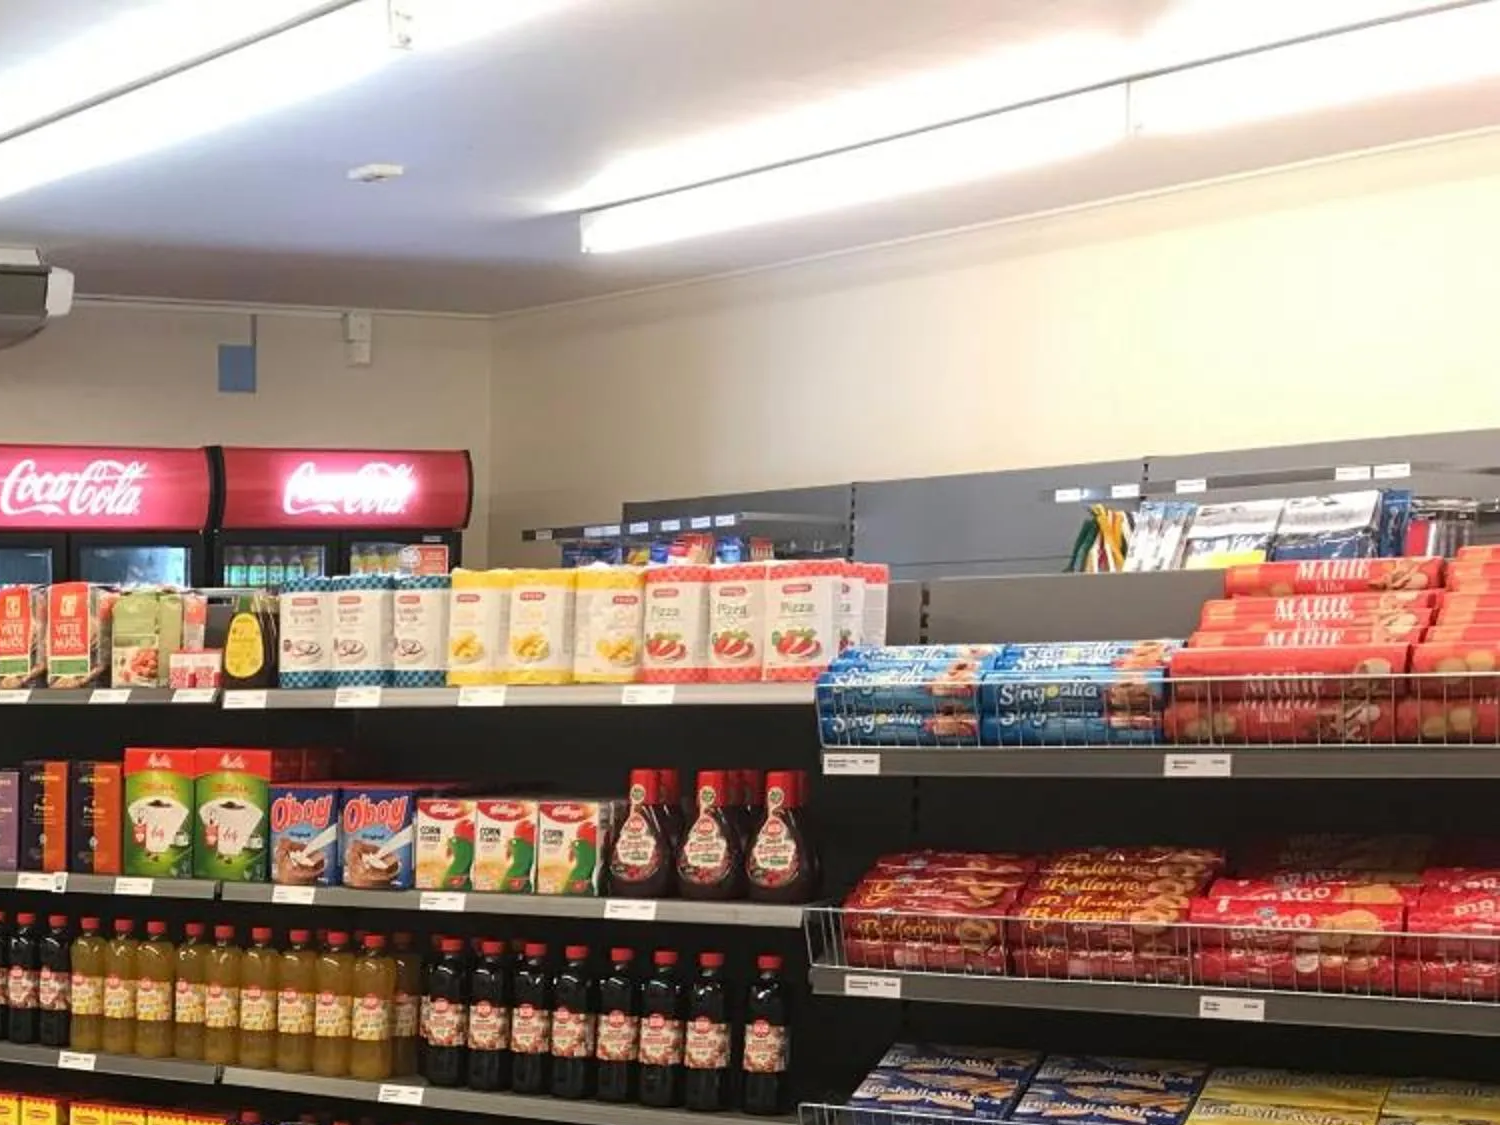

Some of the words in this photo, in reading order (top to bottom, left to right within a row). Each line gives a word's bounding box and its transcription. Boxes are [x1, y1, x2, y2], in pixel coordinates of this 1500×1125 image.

[0, 459, 149, 516] Coca-Cola
[1295, 559, 1371, 580] MARIE
[1274, 597, 1354, 621] MARIE
[1263, 629, 1345, 646] MARIE
[999, 676, 1098, 705] Singoalla
[832, 706, 923, 733] Singoalla
[419, 826, 441, 835] CORN
[479, 827, 502, 836] CORN
[543, 829, 564, 838] CORN
